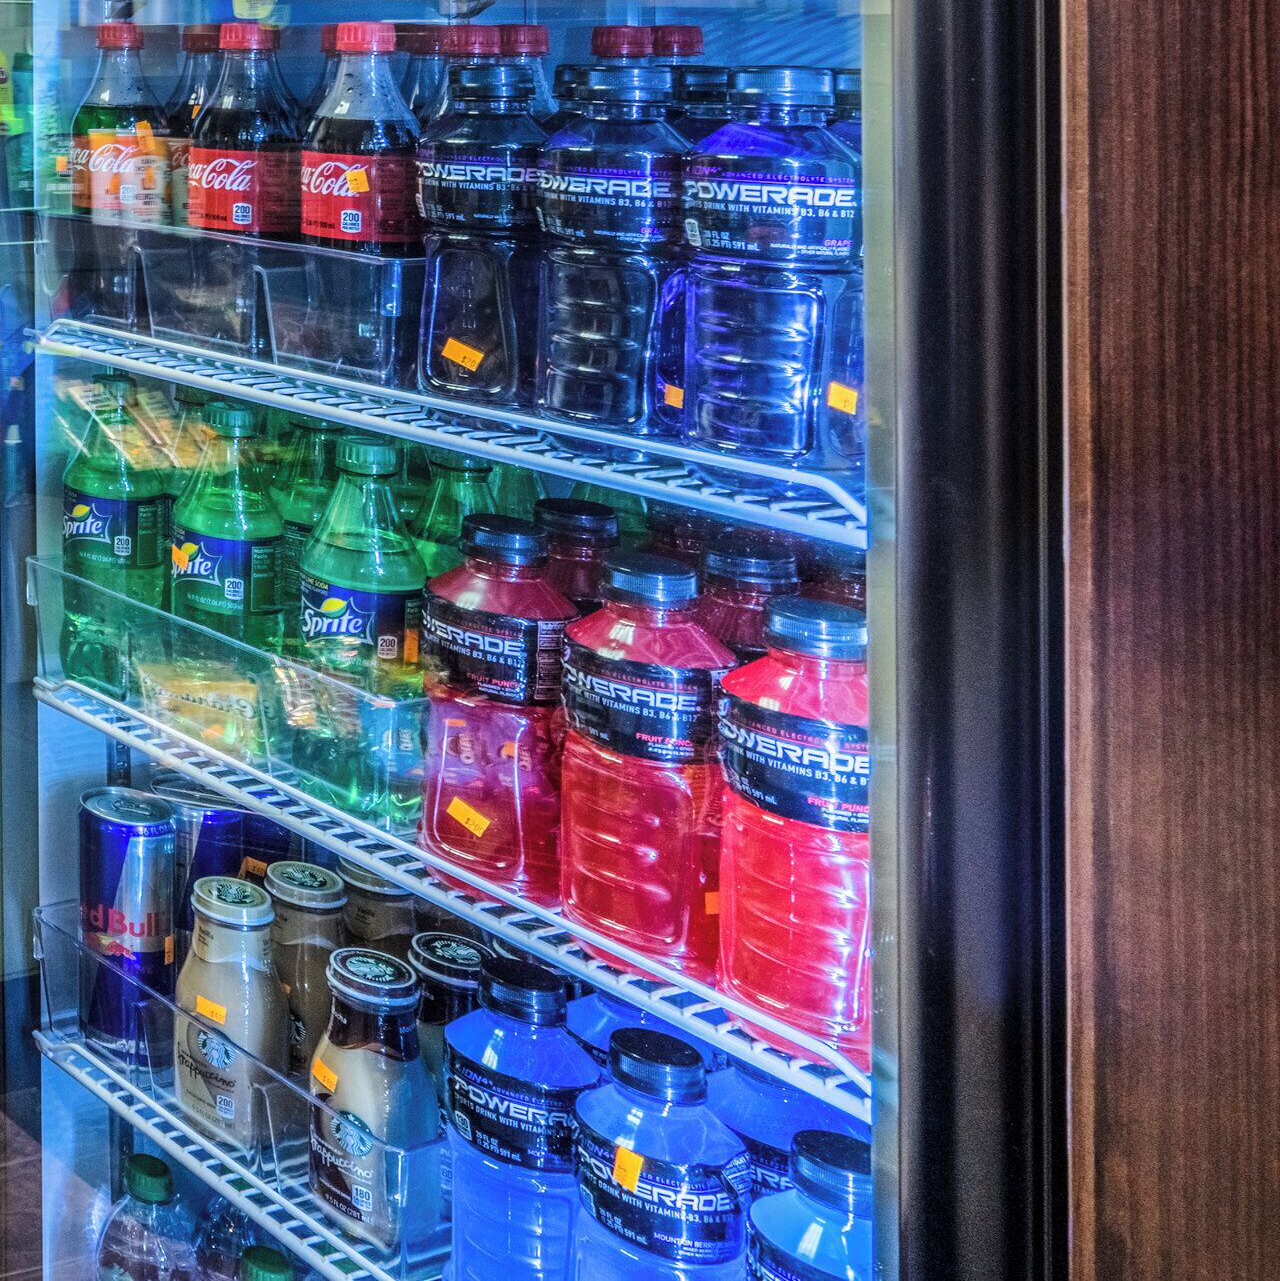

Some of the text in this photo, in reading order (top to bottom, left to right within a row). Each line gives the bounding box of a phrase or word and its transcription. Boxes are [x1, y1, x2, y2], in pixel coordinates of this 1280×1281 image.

[766, 174, 824, 183] ELECTROLYTE
[440, 181, 494, 191] WITH VITAMINS
[683, 181, 857, 207] POWERADE
[577, 194, 647, 207] VITAMINS B6
[234, 205, 251, 215] 200
[703, 201, 855, 218] DRINK WITH VITAMINS B6 & B12
[342, 212, 360, 223] 200
[823, 239, 852, 247] GRAPE
[115, 537, 130, 547] 200
[226, 580, 243, 591] 200
[302, 608, 365, 638] Sprite
[379, 638, 396, 648] 200
[441, 640, 497, 662] VITAMINS B6
[602, 696, 641, 715] VITAMINS
[635, 732, 665, 744] FRUIT
[746, 749, 848, 784] WITH VITAMINS B6
[807, 797, 839, 808] FRUIT
[107, 908, 157, 938] Bull
[217, 1095, 234, 1107] 200
[476, 1104, 518, 1128] DRINK WITH
[354, 1187, 370, 1200] 180
[598, 1181, 643, 1209] DRINK WITH
